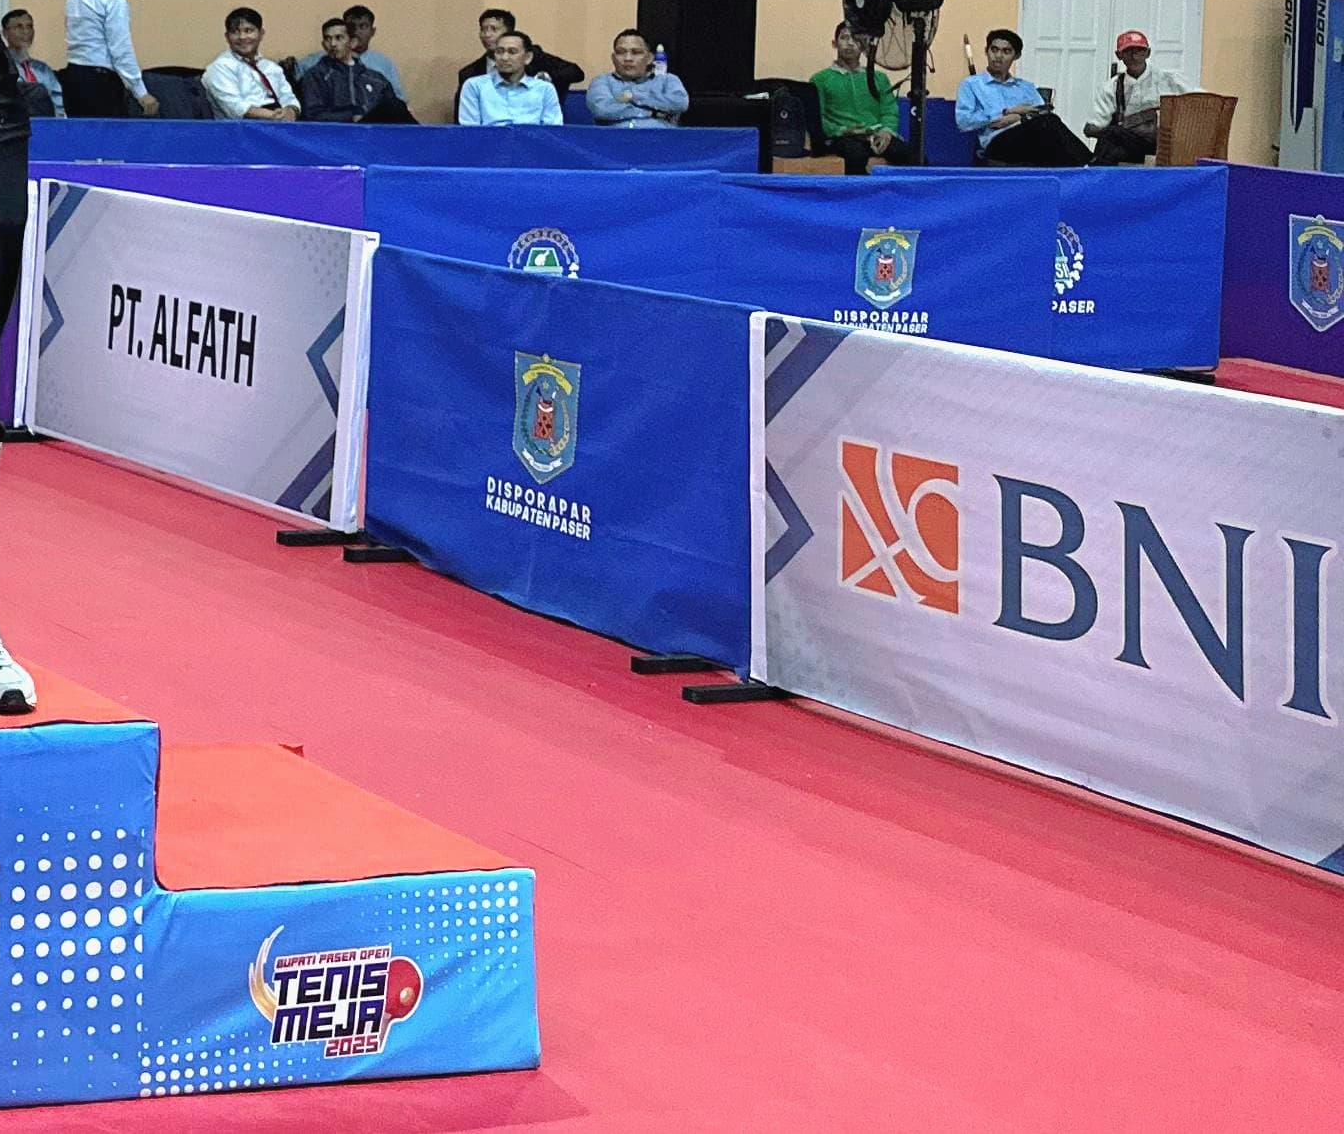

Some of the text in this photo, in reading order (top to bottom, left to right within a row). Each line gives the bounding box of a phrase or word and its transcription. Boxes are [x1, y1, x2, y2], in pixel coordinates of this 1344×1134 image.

[834, 310, 929, 323] DISPORAPAR
[1052, 300, 1095, 313] PASER
[108, 283, 257, 387] PT. ALFATH
[486, 476, 592, 525] DISPORAPAR
[993, 474, 1332, 719] BNI
[277, 948, 390, 969] BUPATI PASER OPEN
[274, 962, 388, 1006] TENIS
[271, 999, 384, 1044] MEJA
[325, 1034, 378, 1057] 2025
